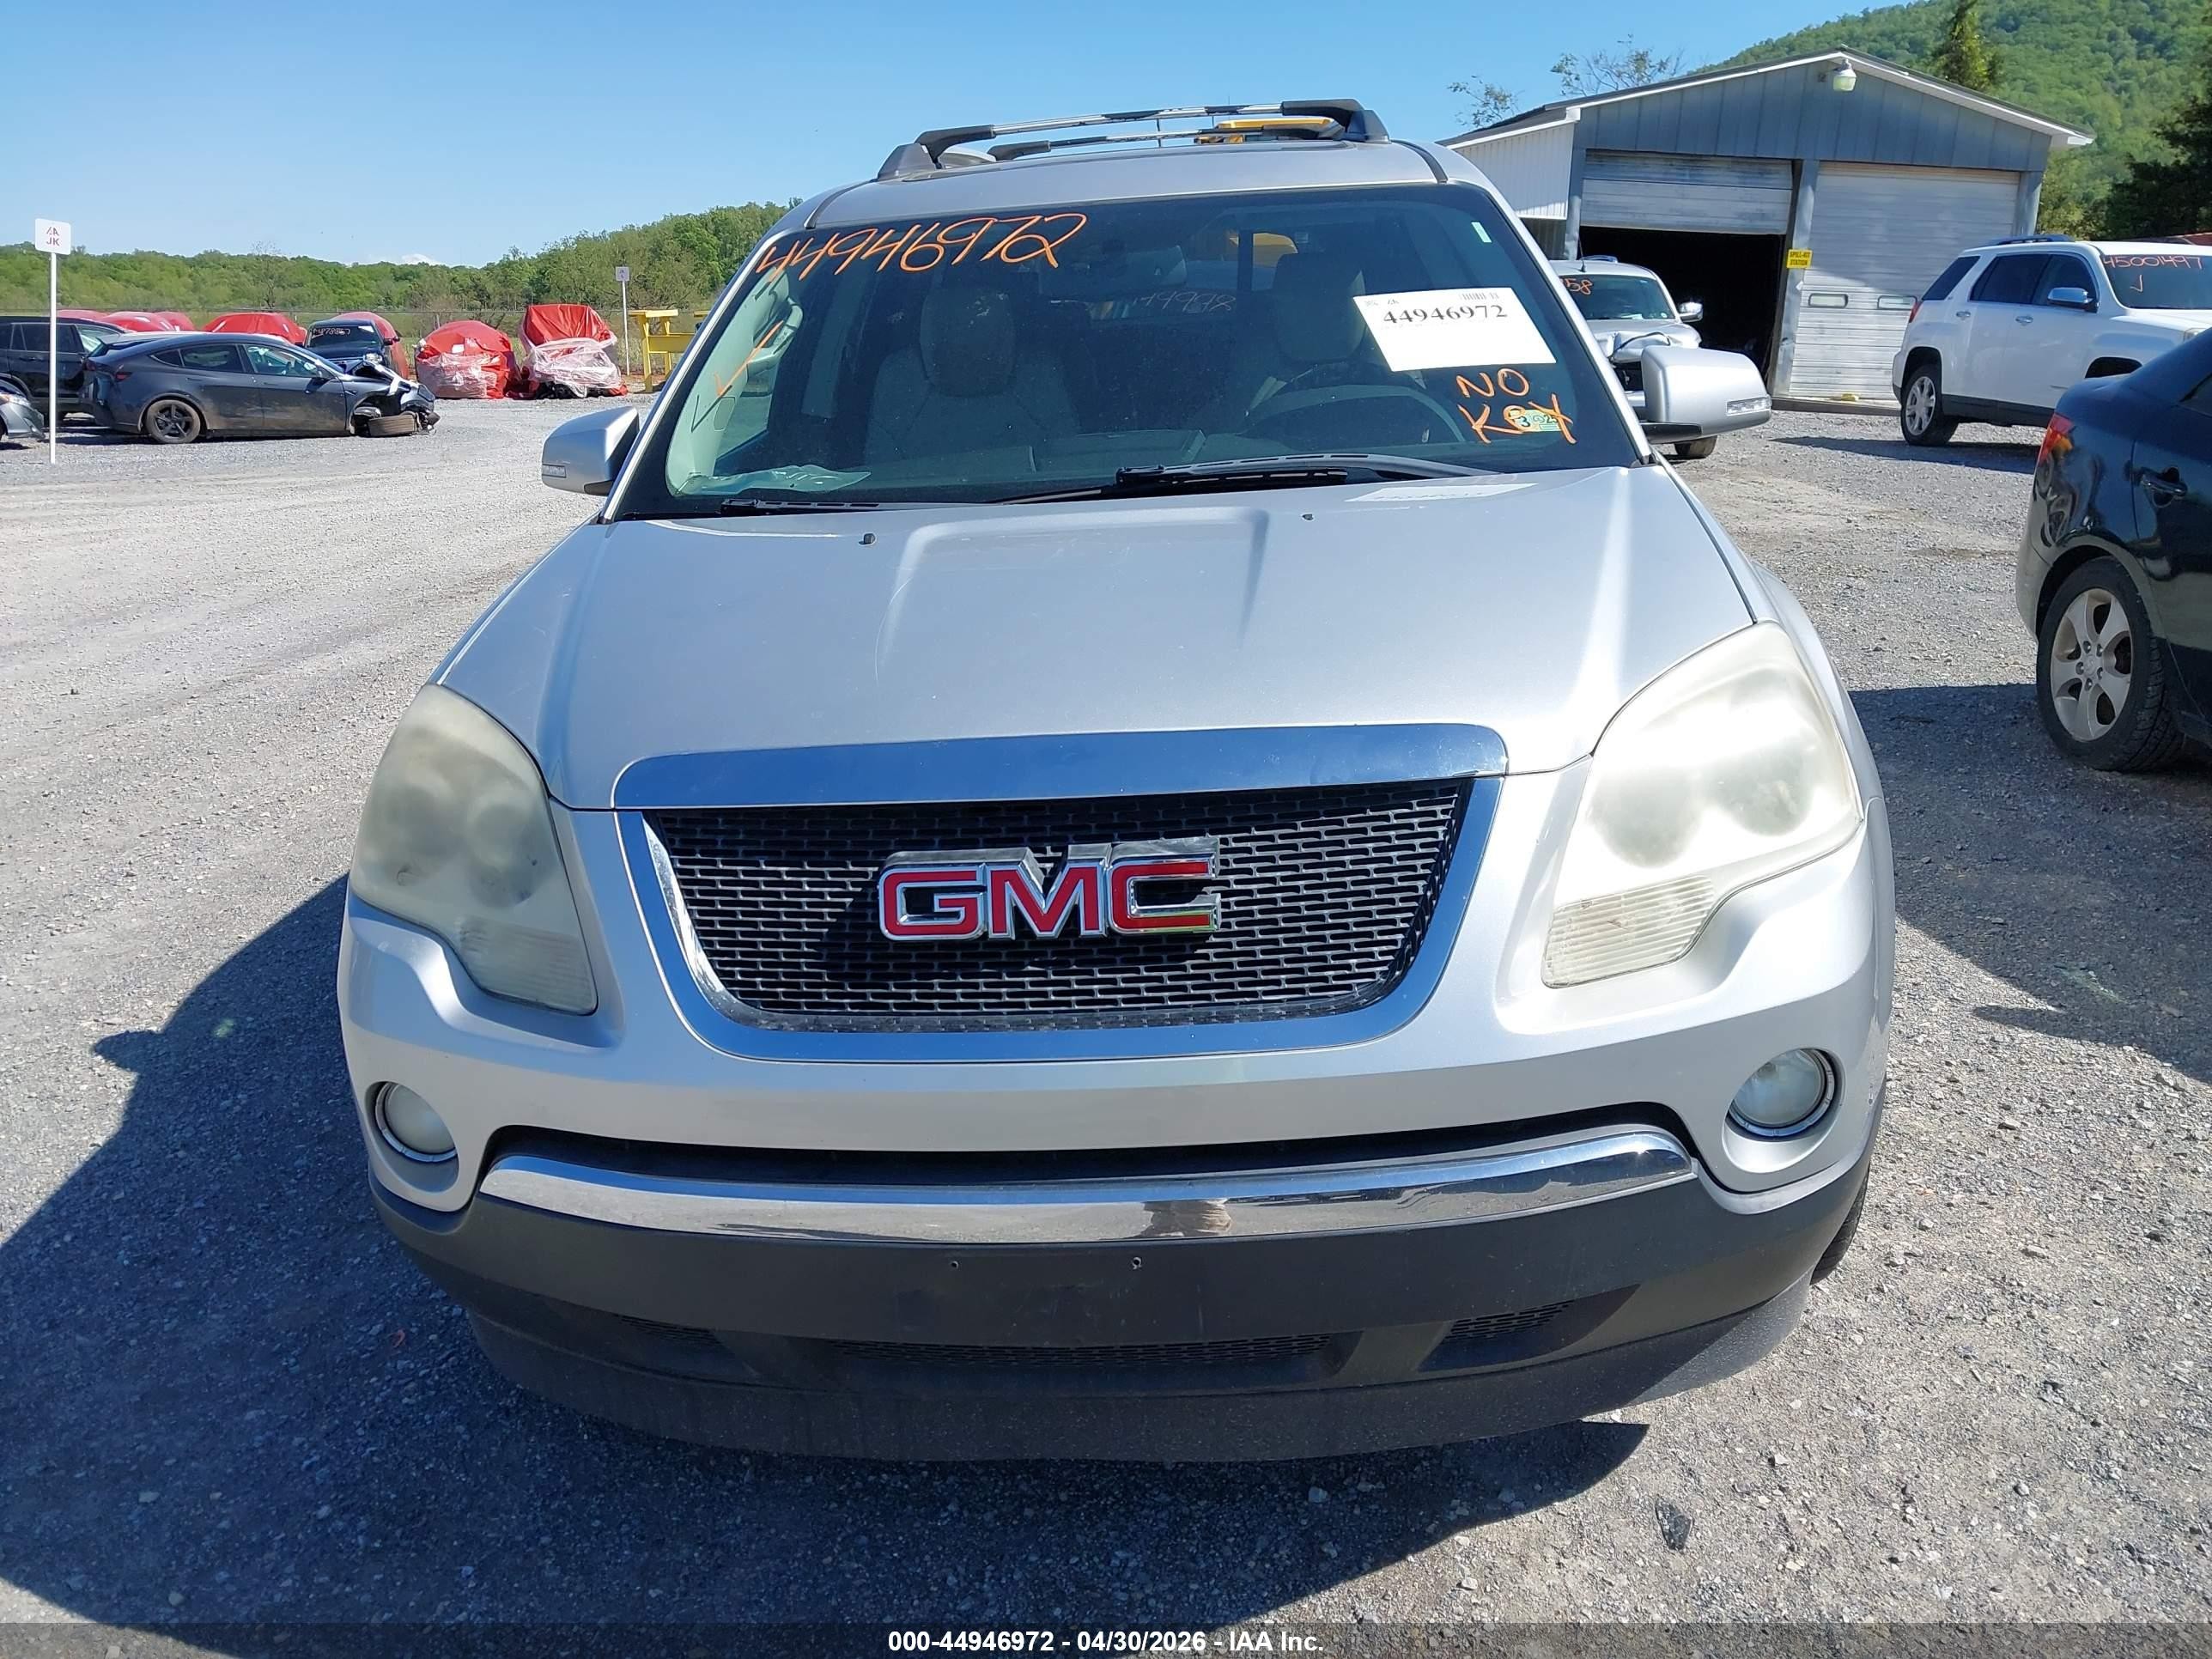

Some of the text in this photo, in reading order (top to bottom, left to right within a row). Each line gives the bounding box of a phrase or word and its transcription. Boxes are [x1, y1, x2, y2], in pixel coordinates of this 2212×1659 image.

[46, 237, 60, 246] JK
[755, 213, 1087, 281] 44946972
[2103, 256, 2203, 270] 45001497
[1560, 277, 1593, 295] 58
[1383, 305, 1508, 323] 44946972
[1455, 368, 1530, 398] NO
[878, 838, 1220, 940] GMC
